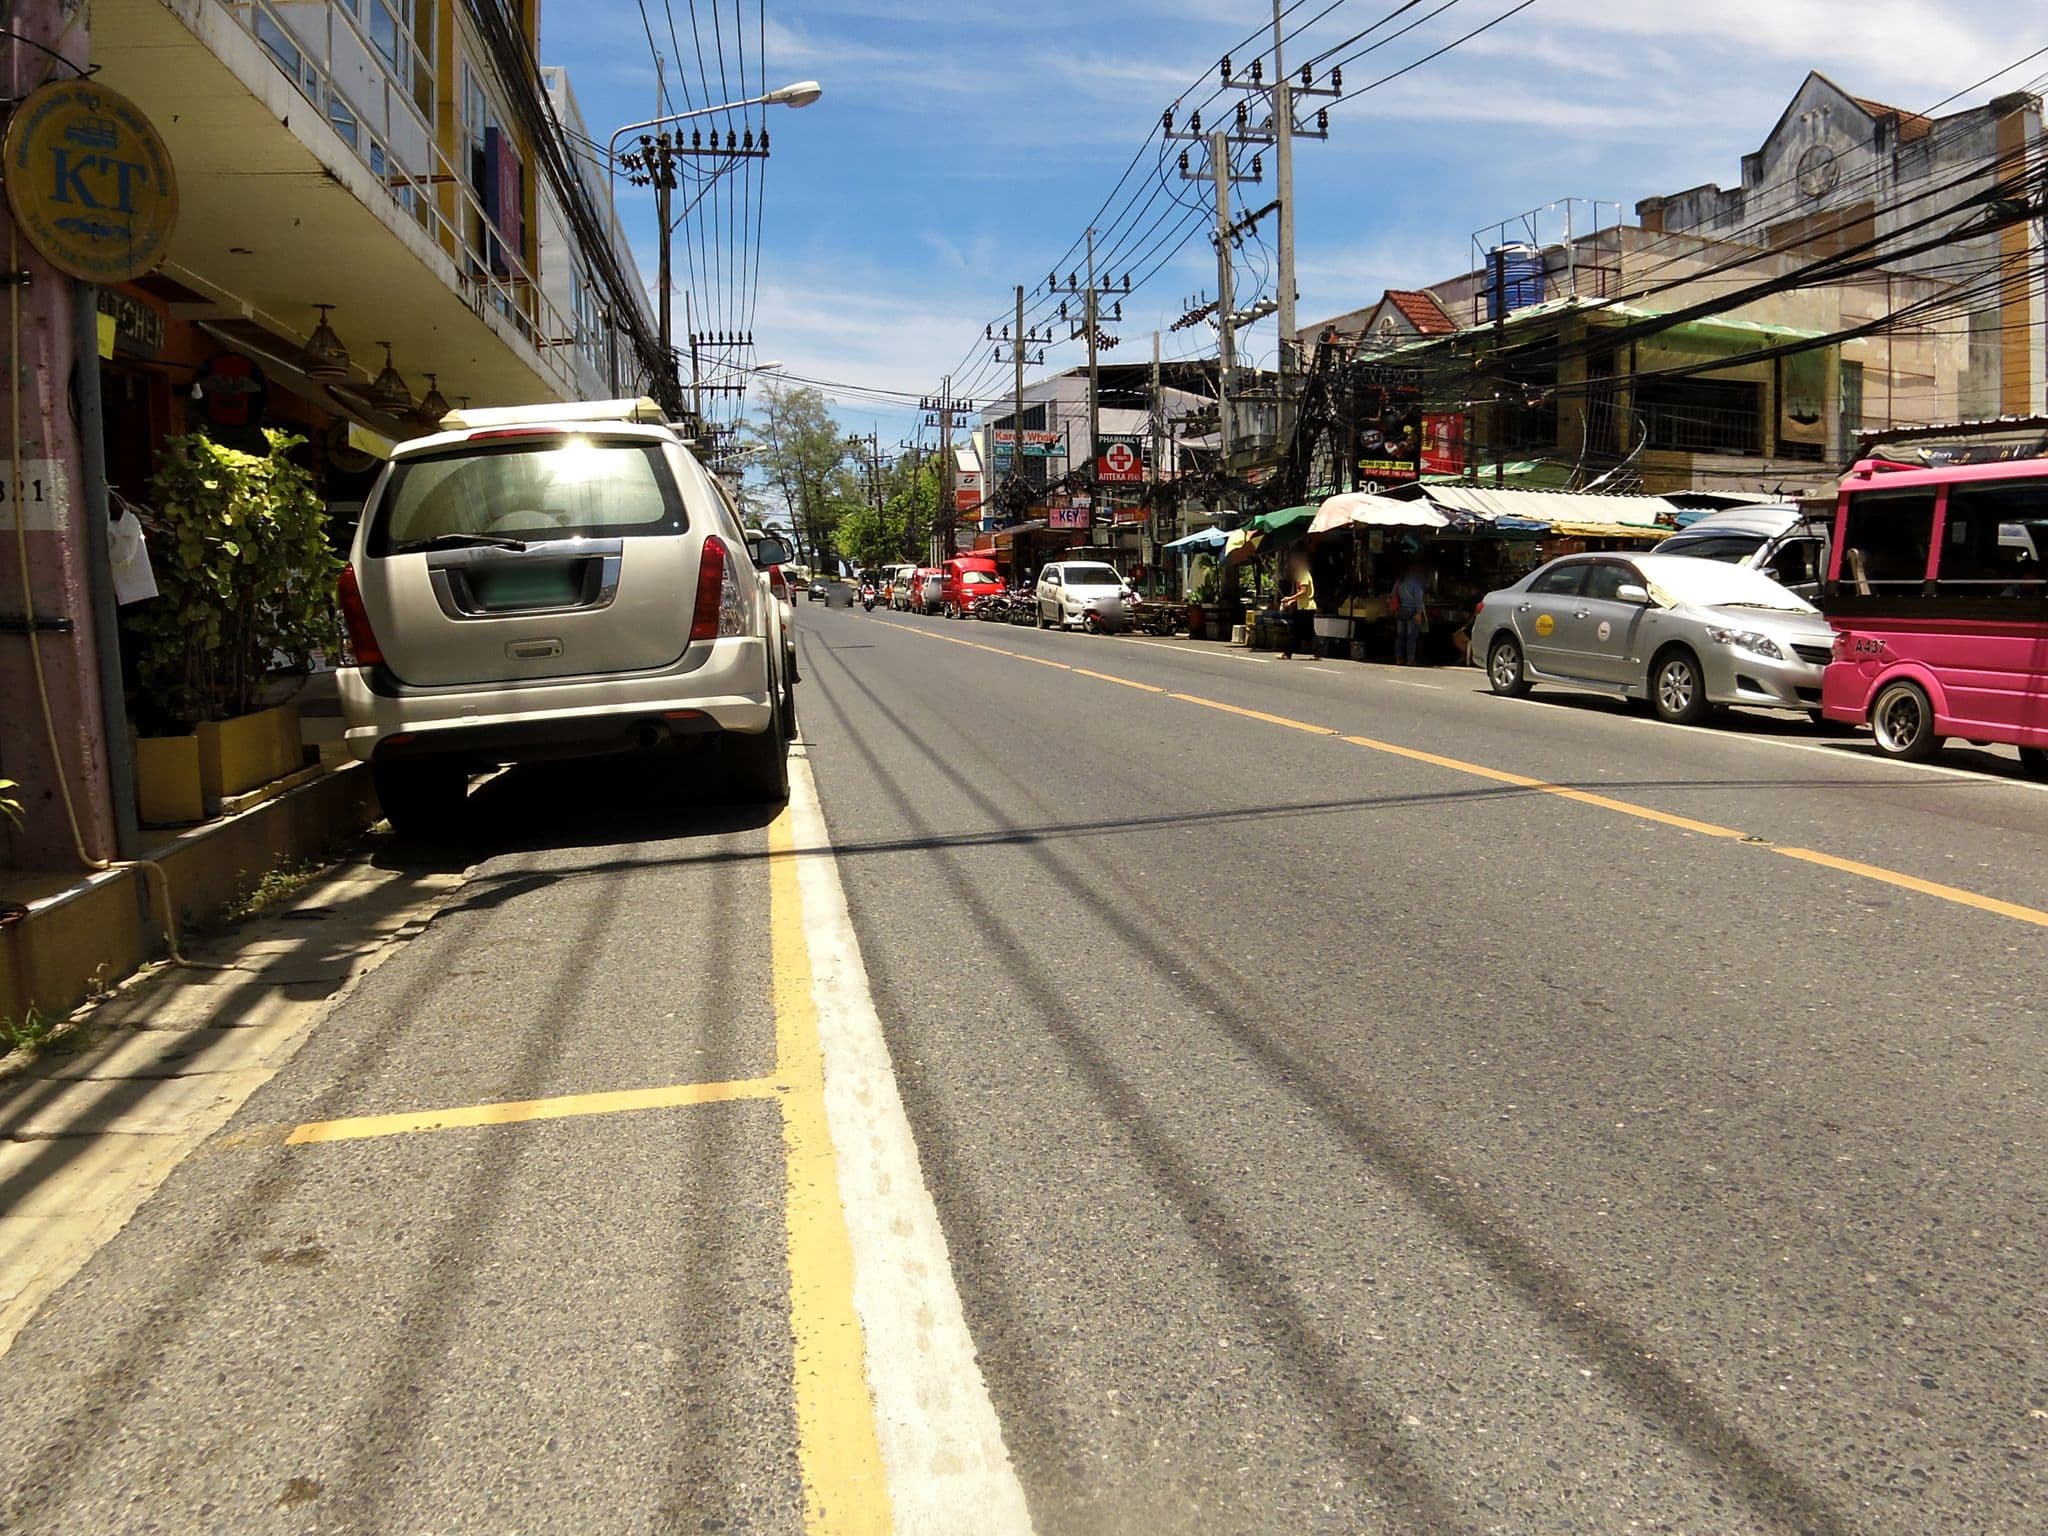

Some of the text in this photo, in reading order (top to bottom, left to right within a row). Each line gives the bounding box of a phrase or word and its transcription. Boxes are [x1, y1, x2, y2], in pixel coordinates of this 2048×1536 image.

[49, 147, 148, 214] KT
[1099, 436, 1140, 444] PHARMACY
[1059, 509, 1080, 522] KEY
[1855, 639, 1886, 653] A437
